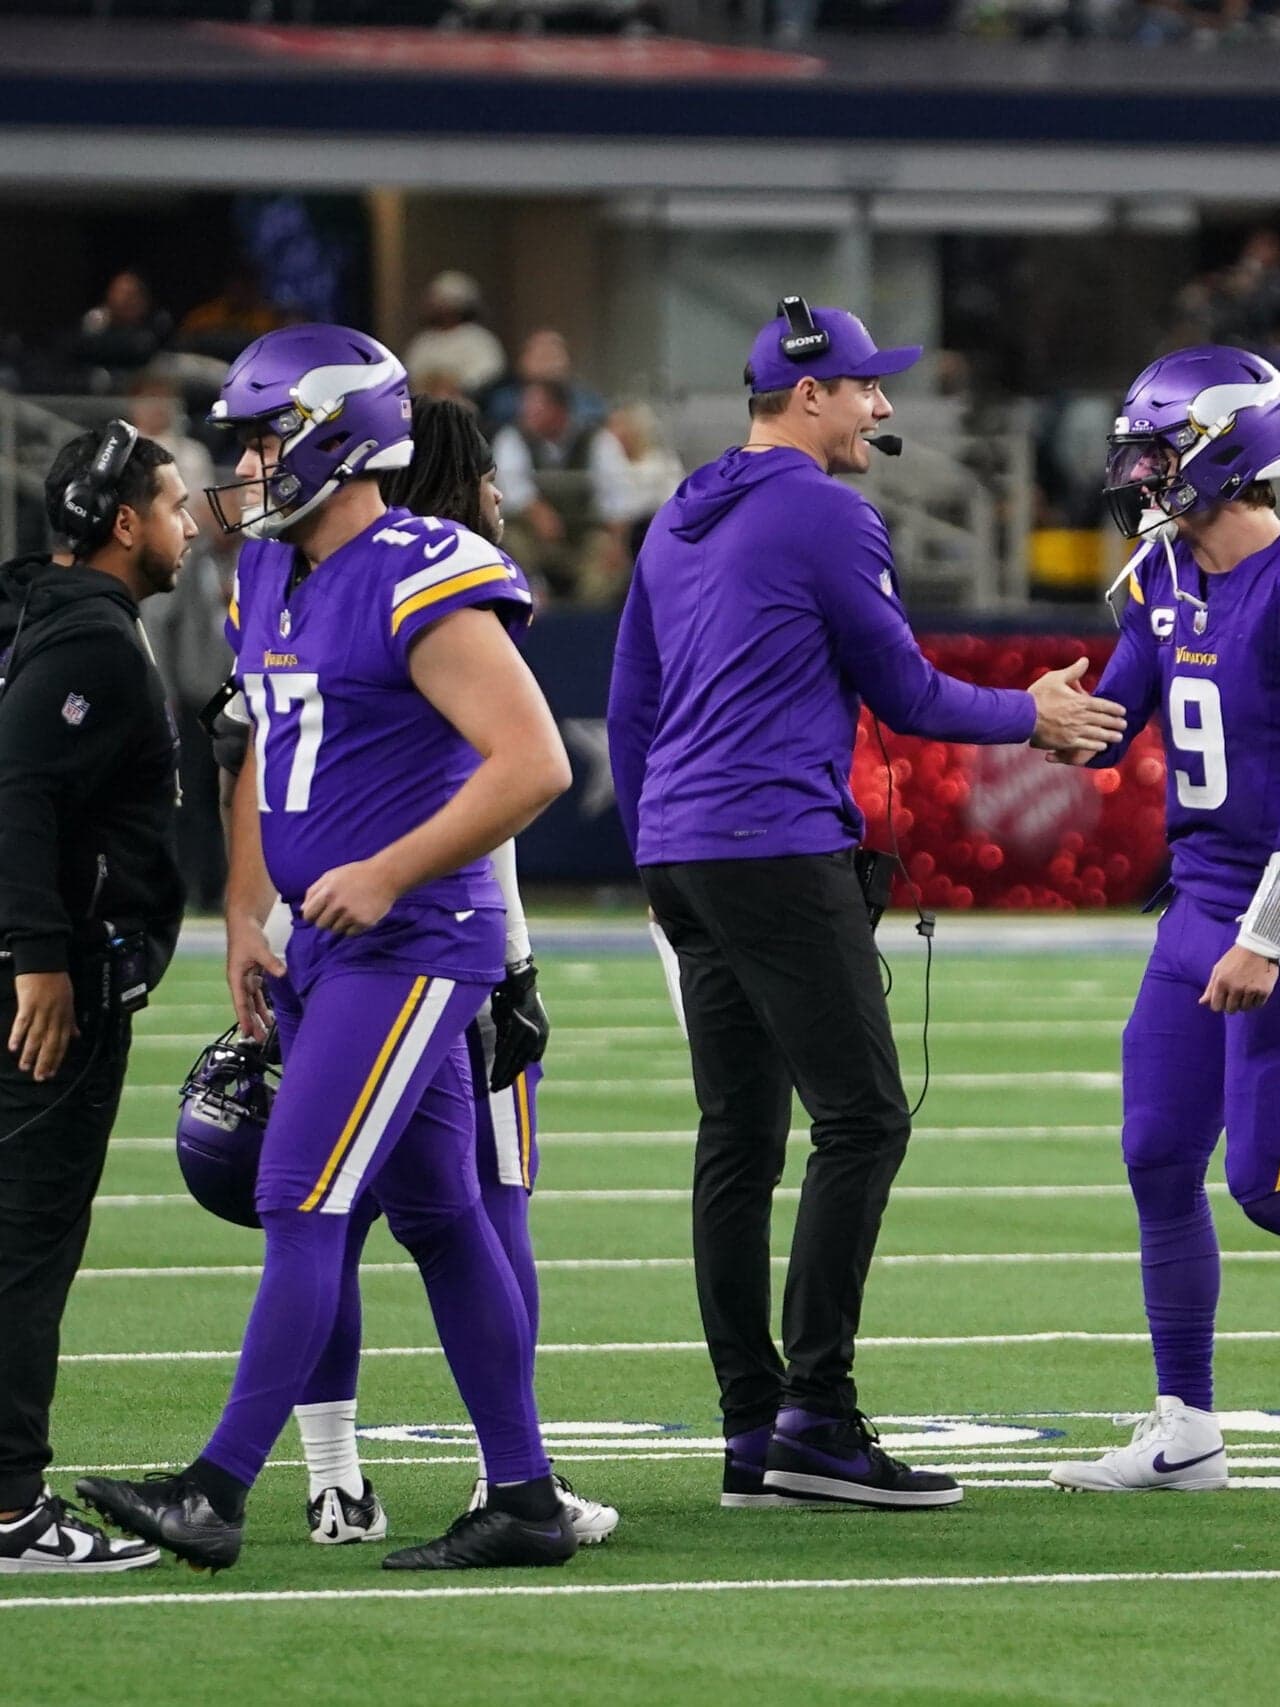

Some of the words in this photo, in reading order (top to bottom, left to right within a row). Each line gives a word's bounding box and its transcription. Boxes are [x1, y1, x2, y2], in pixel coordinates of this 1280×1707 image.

[785, 334, 824, 350] SONY
[97, 436, 119, 472] SONY
[66, 501, 101, 524] SOY
[1151, 608, 1175, 636] C
[242, 672, 325, 813] 17
[1168, 675, 1228, 811] 9
